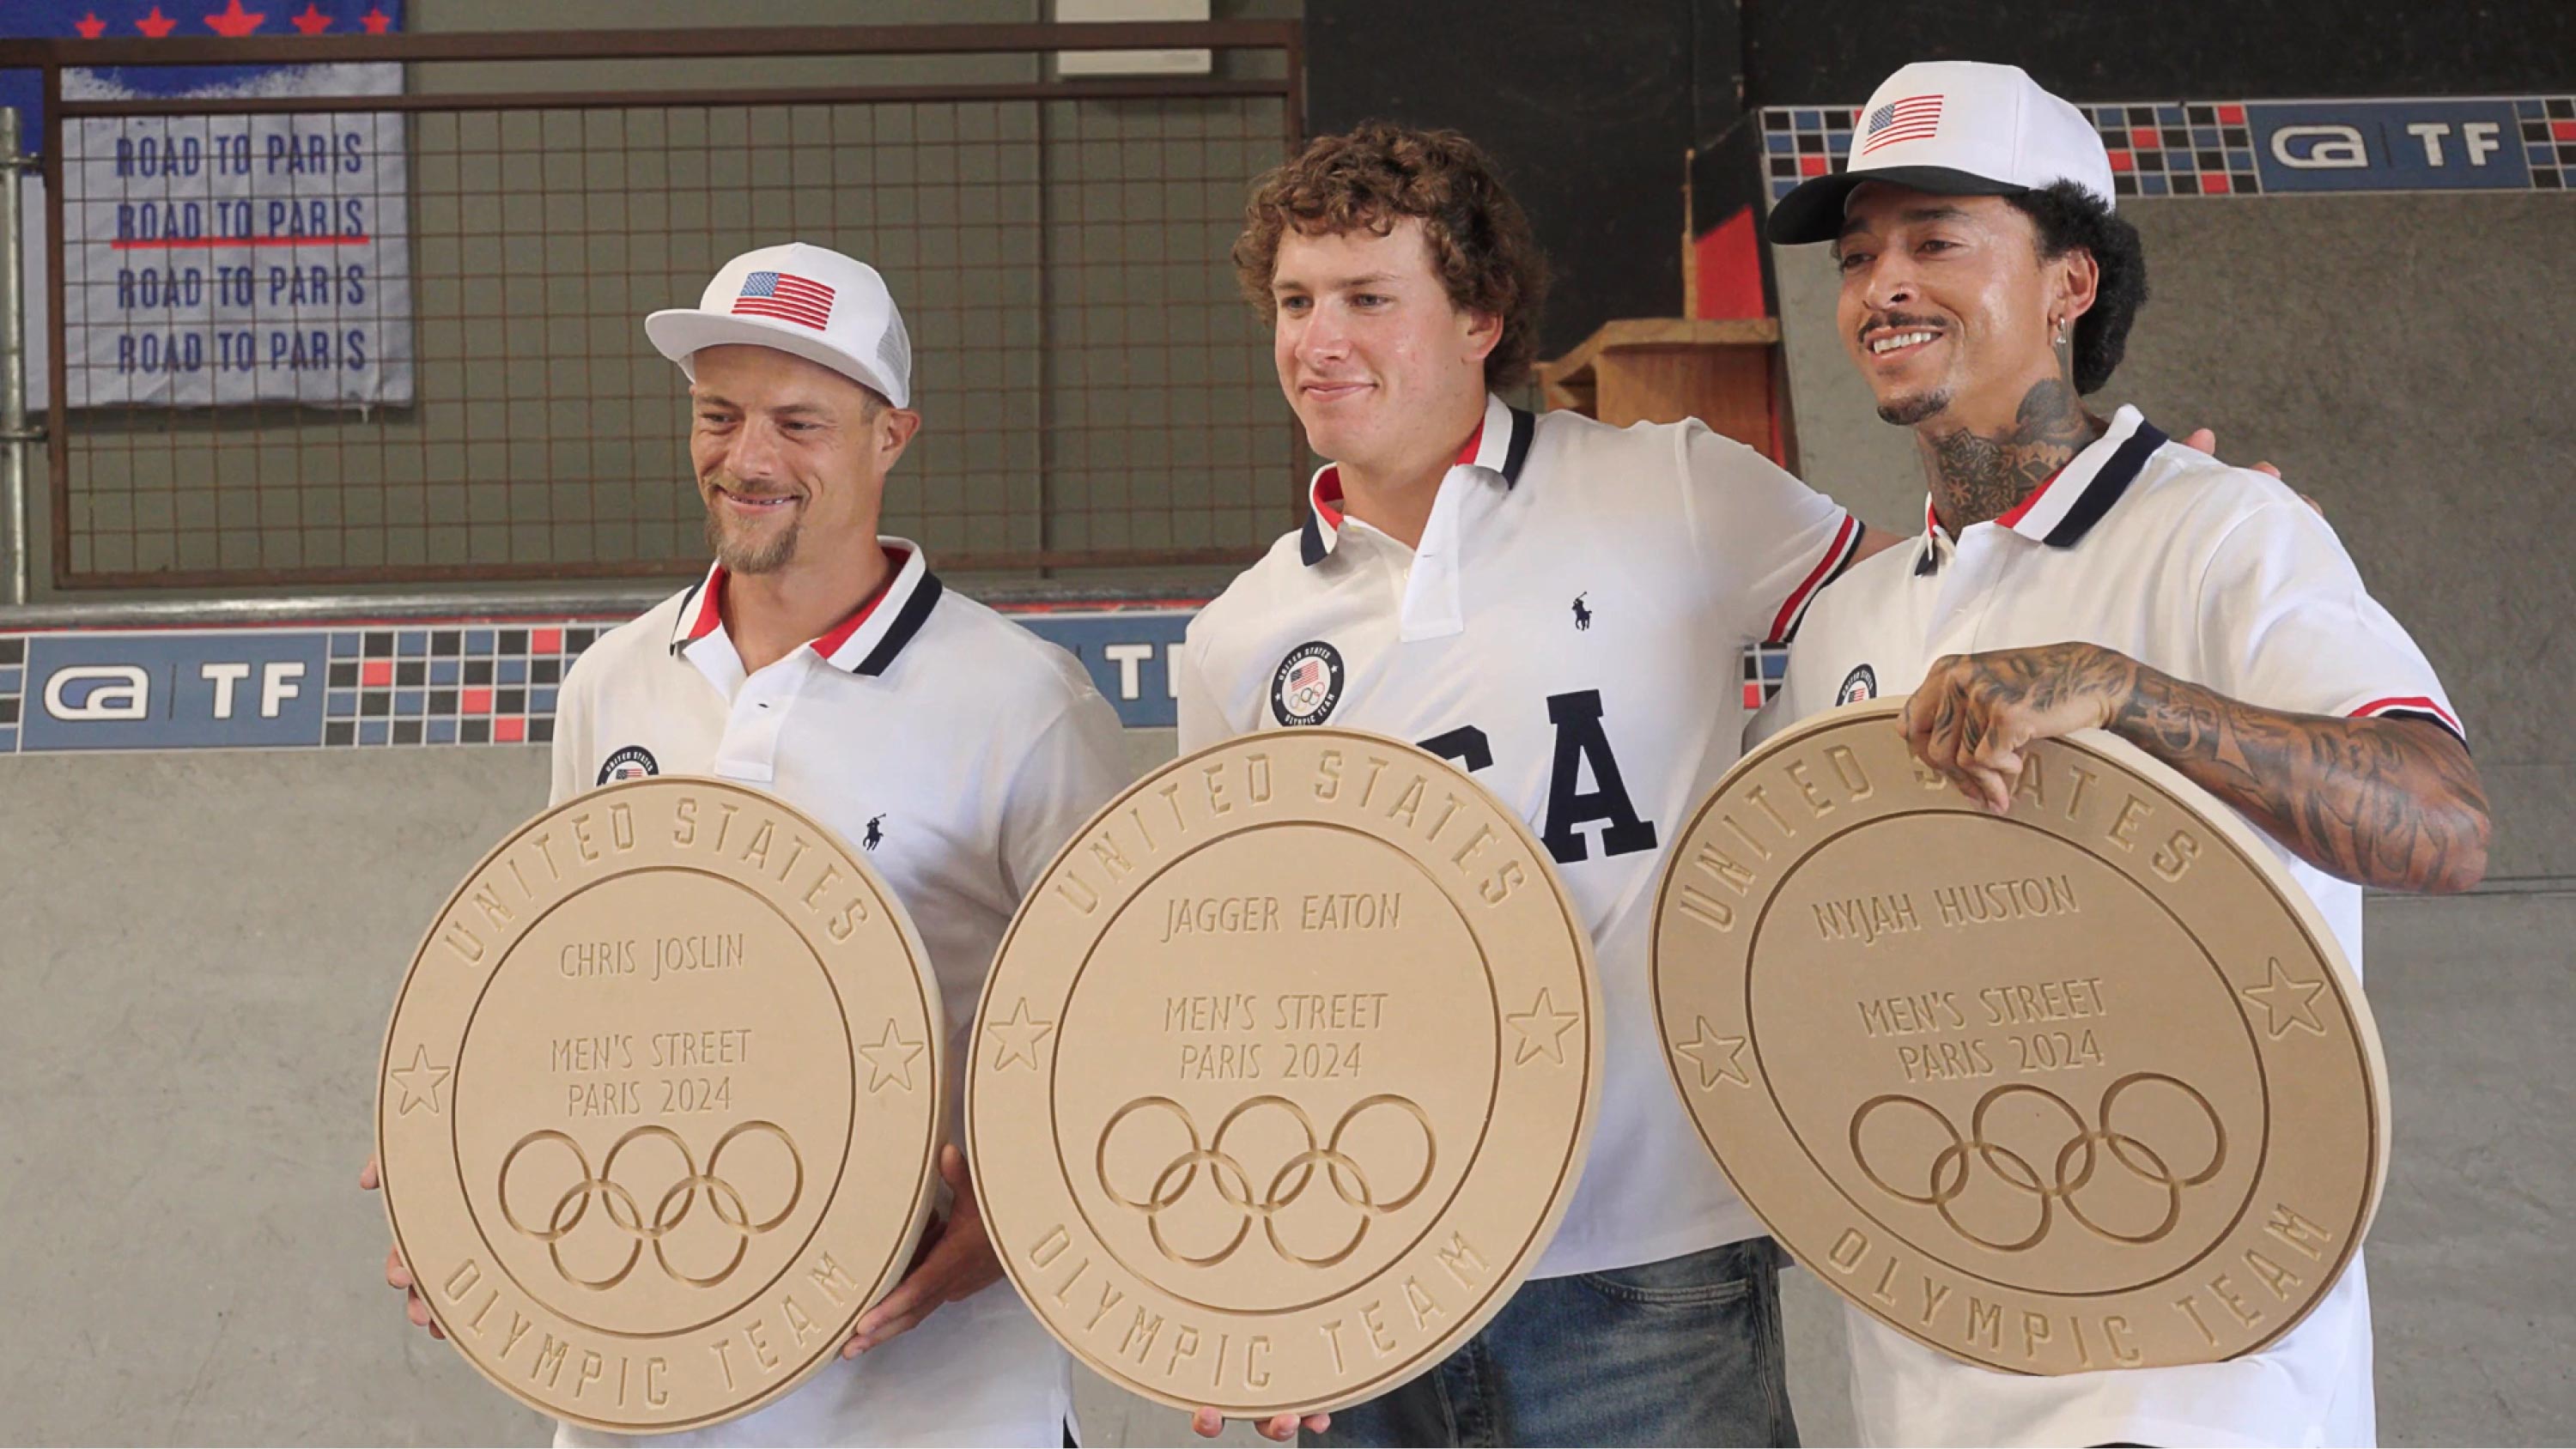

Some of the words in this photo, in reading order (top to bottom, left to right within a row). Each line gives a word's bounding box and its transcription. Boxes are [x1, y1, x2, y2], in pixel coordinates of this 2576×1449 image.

[116, 136, 200, 178] ROAD
[216, 134, 251, 174] TO
[267, 132, 361, 173] PARIS
[2407, 123, 2500, 167] TF
[117, 202, 201, 239] ROAD
[217, 200, 252, 238] TO
[268, 198, 362, 237] PARIS
[118, 267, 201, 308] ROAD
[218, 266, 253, 307] TO
[270, 264, 364, 306] PARIS
[118, 332, 202, 374] ROAD
[218, 331, 254, 372] TO
[270, 330, 365, 371] PARIS
[201, 661, 305, 719] TF
[1056, 752, 1273, 915] UNITED
[1314, 749, 1528, 908] STATES
[1680, 744, 1874, 933] UNITED
[1914, 749, 2203, 882] ATES
[444, 802, 636, 967] UNITED
[672, 797, 869, 945] STATES
[1160, 896, 1280, 943] JAGGER
[1301, 893, 1401, 931] EATON
[1811, 894, 1921, 947] NYJAH
[1934, 875, 2081, 928] HUSTON
[561, 939, 636, 977] CHRIS
[651, 933, 744, 981] JOSLIN
[1163, 993, 1256, 1032] MEN'S
[1274, 992, 1388, 1030] STREET
[1857, 991, 1965, 1038] MEN'S
[1979, 977, 2107, 1026] STREET
[551, 1034, 634, 1072] MEN'S
[652, 1028, 752, 1068] STREET
[1180, 1043, 1261, 1080] PARIS
[1281, 1042, 1362, 1079] 2024
[1898, 1039, 1995, 1082] PARIS
[2008, 1029, 2105, 1072] 2024
[568, 1081, 641, 1118] PARIS
[660, 1076, 732, 1113] 2024
[1029, 1223, 1271, 1389] OLYMPIC
[1320, 1230, 1491, 1374] TEAM
[1828, 1226, 2142, 1367] OLYMPIC
[2171, 1203, 2331, 1346] TEAM
[442, 1258, 668, 1409] OLYMPIC
[709, 1250, 858, 1391] TEAM
